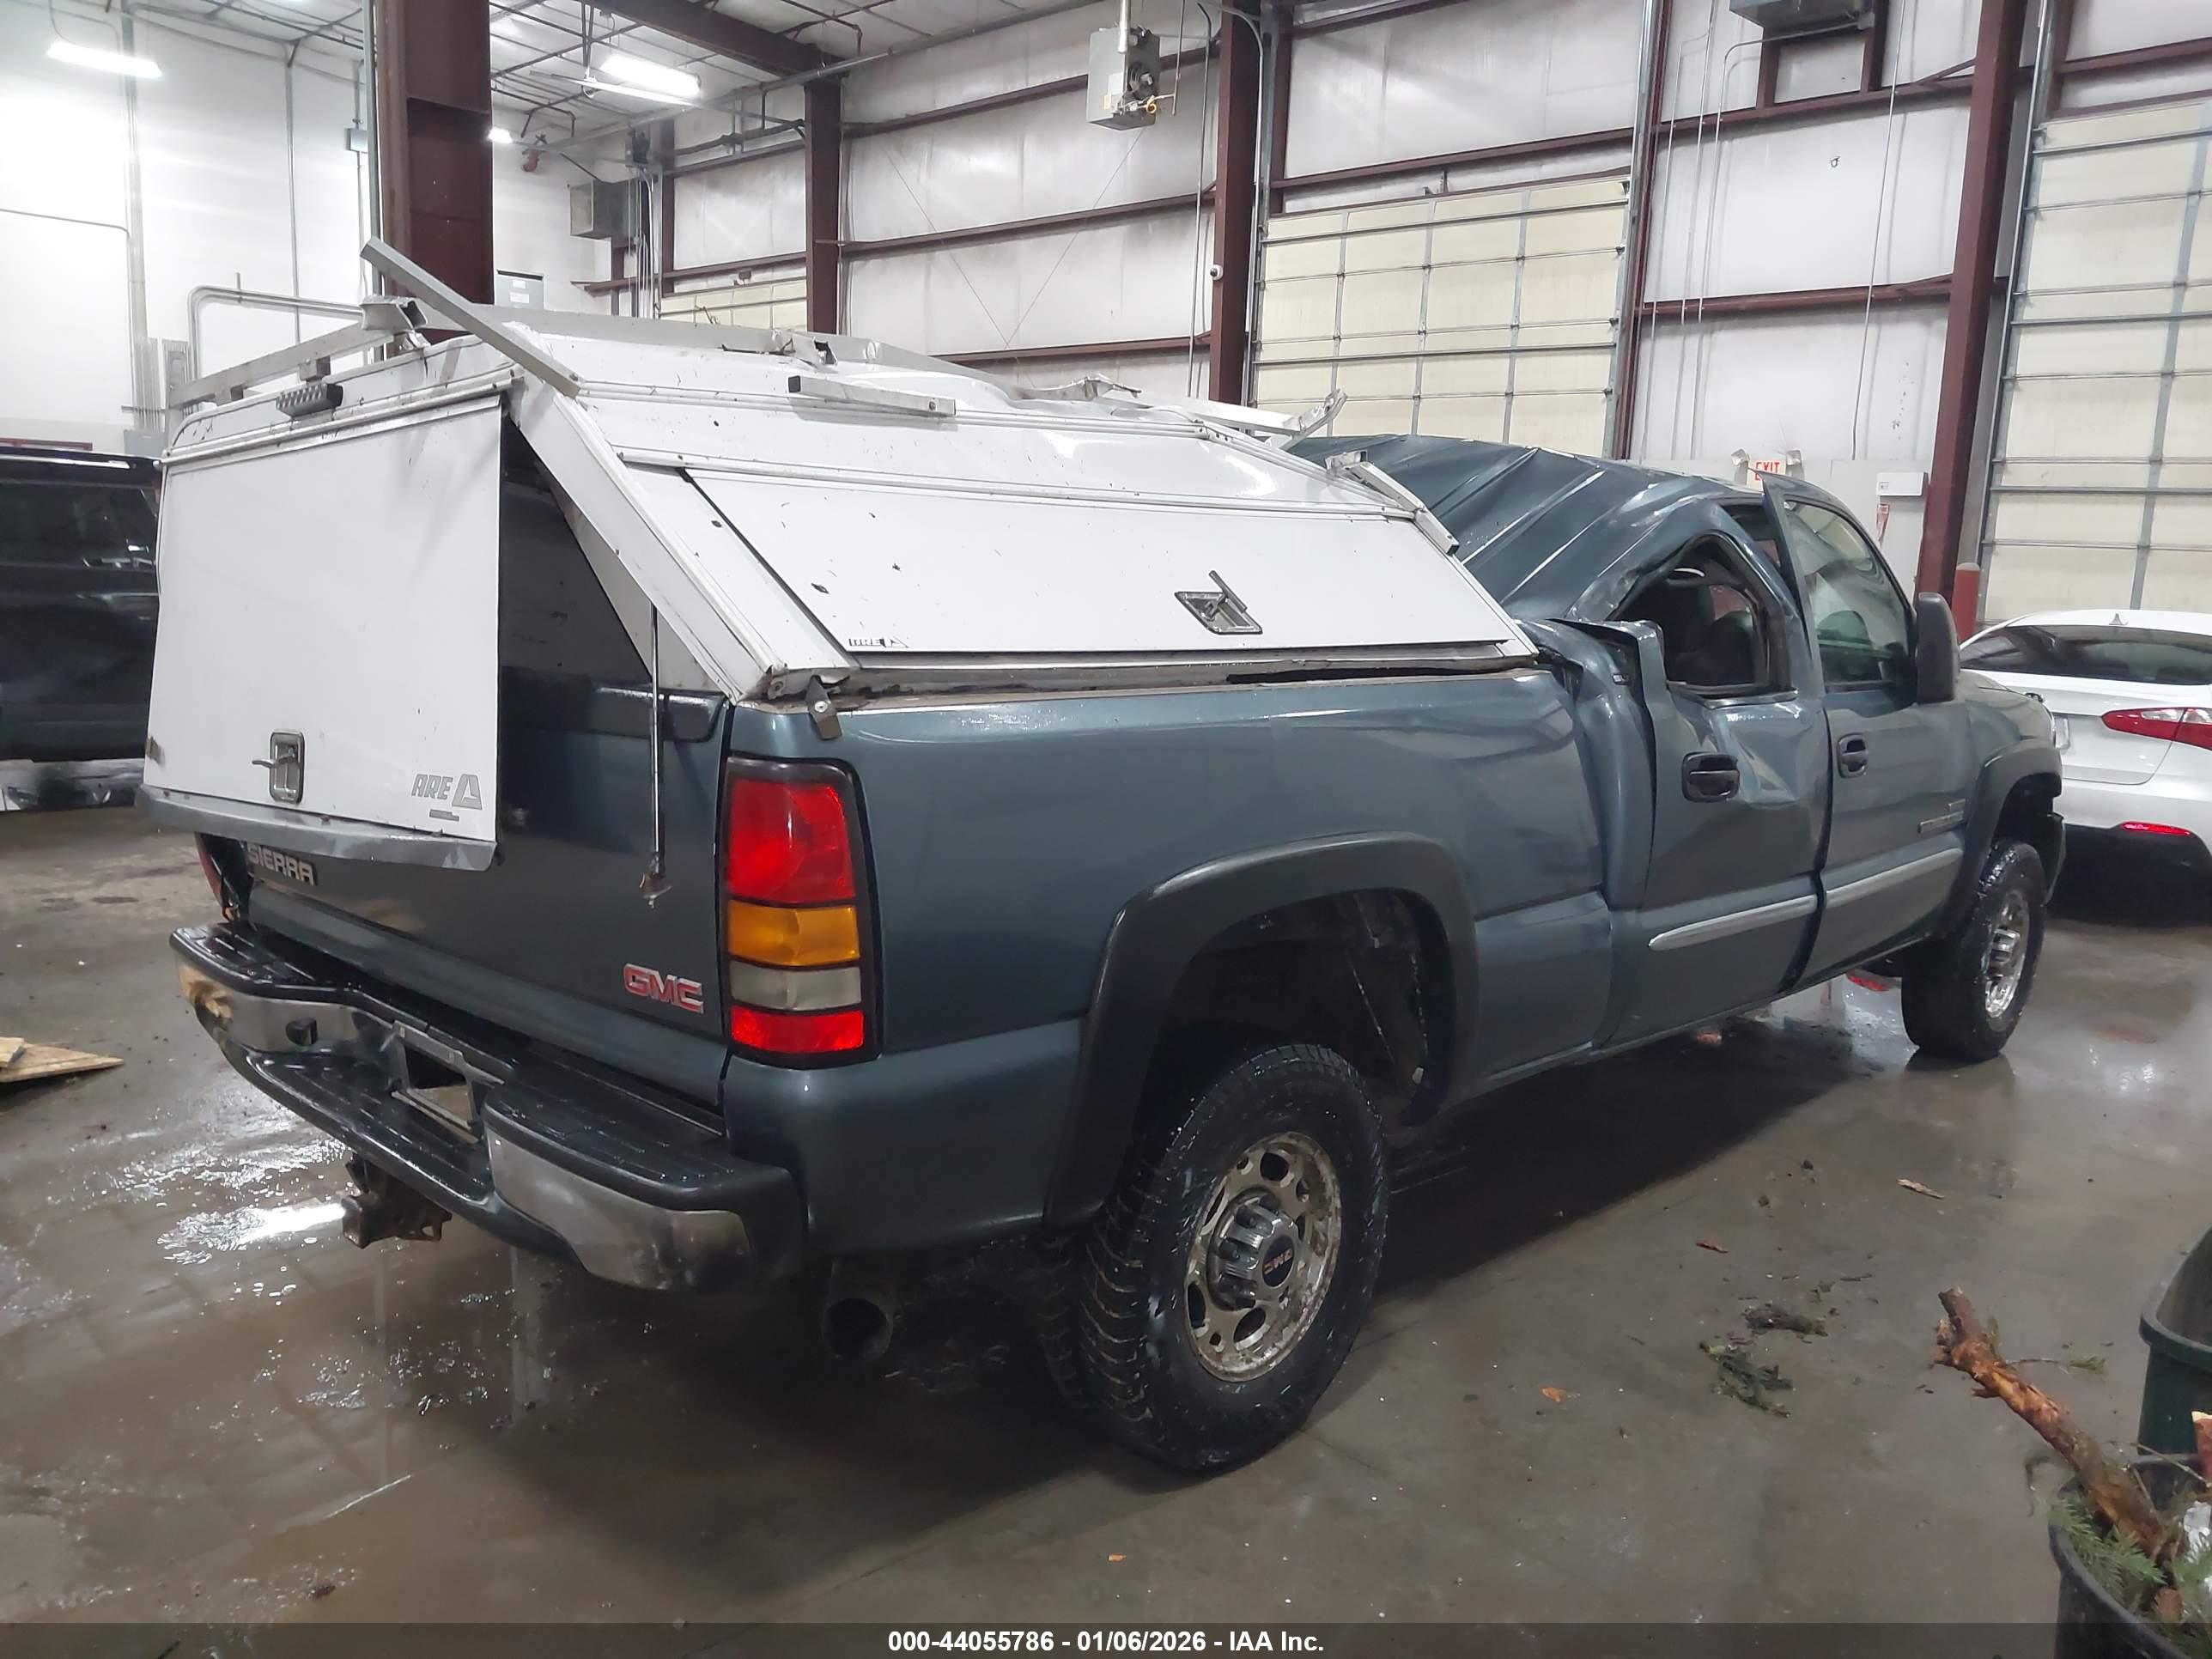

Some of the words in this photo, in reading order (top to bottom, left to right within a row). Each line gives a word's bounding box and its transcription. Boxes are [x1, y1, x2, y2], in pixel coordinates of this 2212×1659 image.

[411, 774, 454, 800] ARE
[247, 843, 314, 887] SIERRA
[623, 963, 704, 1014] GMC
